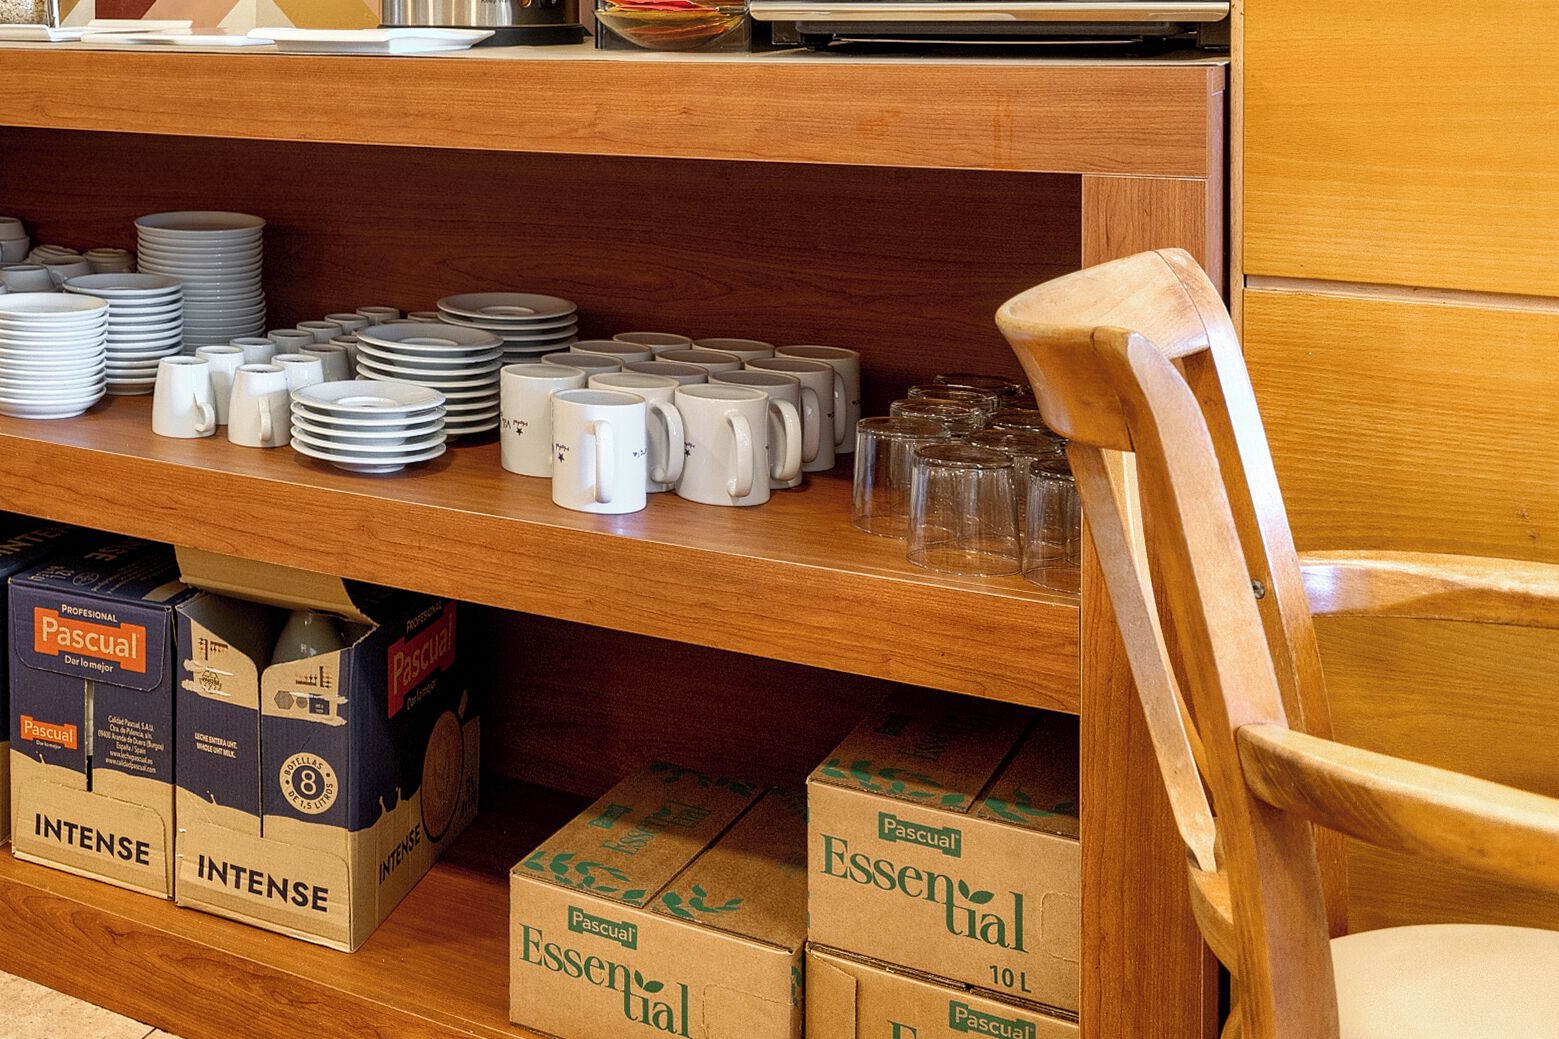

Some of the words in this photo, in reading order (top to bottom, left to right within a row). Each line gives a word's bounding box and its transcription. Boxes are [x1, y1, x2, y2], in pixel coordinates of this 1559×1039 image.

[61, 603, 118, 623] PROFESIONAL
[42, 616, 137, 659] Pascual
[64, 654, 79, 665] Dar
[81, 658, 88, 668] lo
[89, 661, 114, 673] mejor
[392, 612, 453, 695] Pascual
[24, 720, 73, 743] Pascual
[108, 715, 124, 726] Calidad
[194, 732, 209, 743] LECHE
[209, 735, 227, 747] ENTERA
[196, 742, 213, 754] WHOLE
[213, 746, 223, 755] UHT
[284, 757, 324, 777] BOTELLAS
[300, 769, 317, 796] 8
[288, 790, 298, 802] DE
[300, 800, 312, 810] 1,5
[314, 783, 334, 809] LITROS
[35, 813, 150, 866] INTENSE
[884, 817, 956, 850] Pascual
[378, 822, 422, 886] INTENSE
[197, 854, 329, 913] INTENSE
[819, 832, 1030, 954] Essential
[572, 910, 634, 943] Pascual
[519, 923, 694, 1039] Essential
[989, 965, 1015, 989] 10
[1020, 972, 1032, 994] L
[955, 1006, 1031, 1039] Pascual
